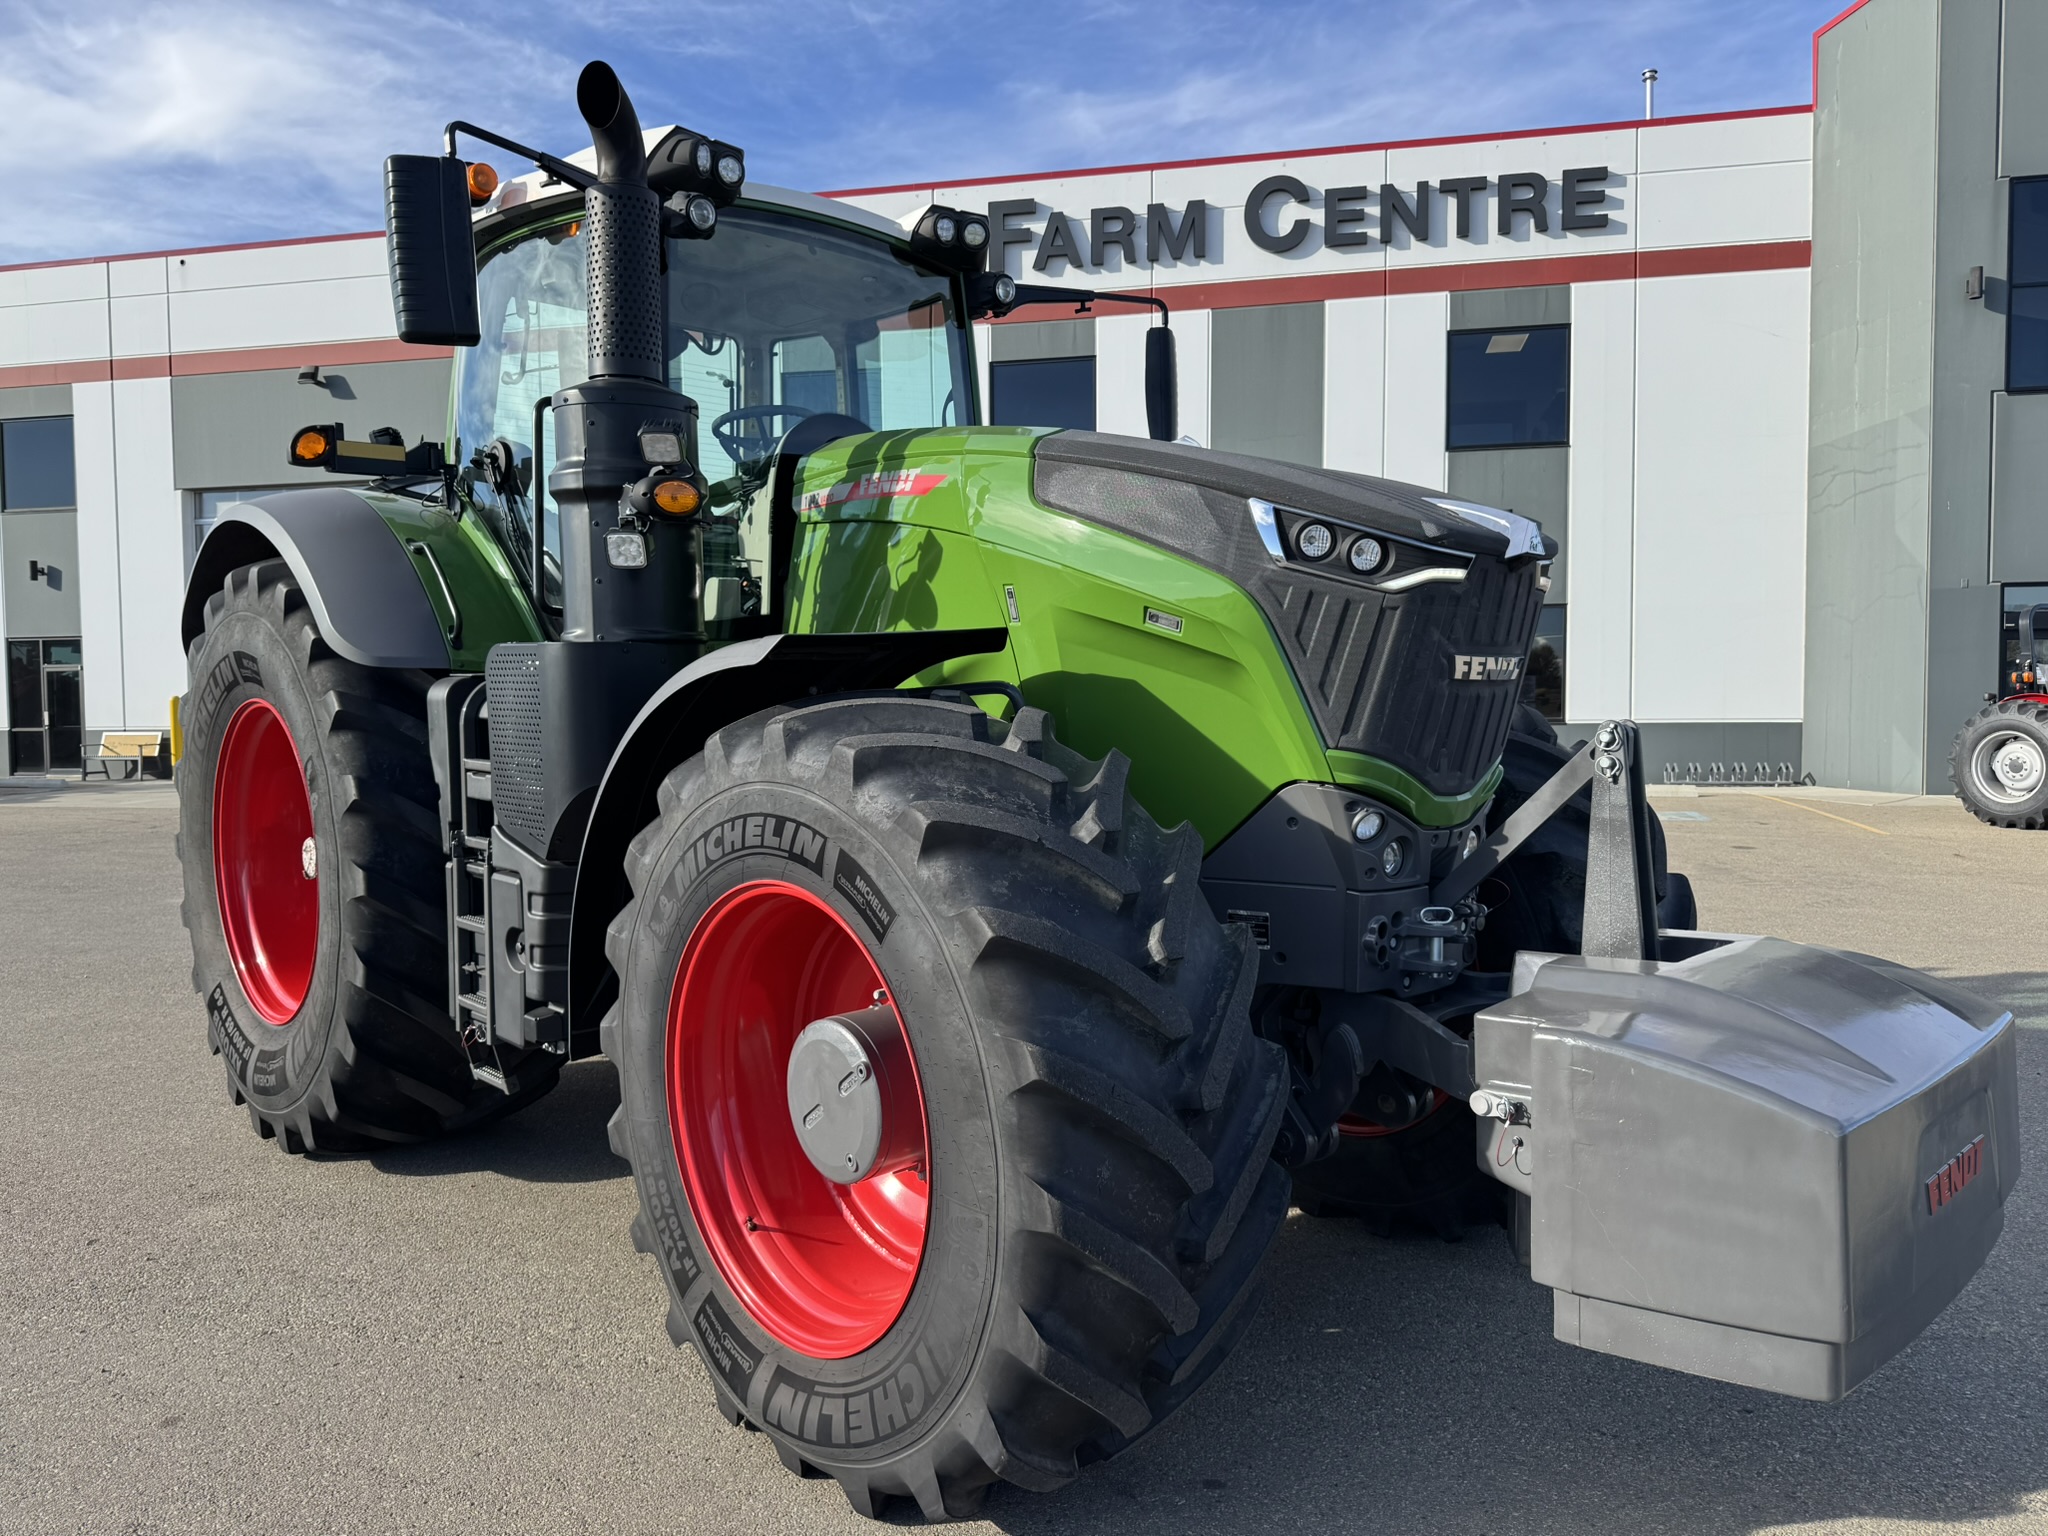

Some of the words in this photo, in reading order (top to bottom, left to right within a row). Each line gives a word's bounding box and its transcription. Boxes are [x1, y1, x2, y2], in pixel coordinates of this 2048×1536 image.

[988, 198, 1206, 272] FARM
[1245, 166, 1610, 253] CENTRE
[859, 467, 922, 495] FENDT
[1454, 654, 1525, 680] FENDT
[185, 656, 235, 785] ICHELIN
[673, 815, 826, 898] MICHELIN
[855, 875, 890, 925] MICHELIN
[1925, 1134, 1985, 1216] FENDT
[658, 1178, 687, 1252] 710/60
[683, 1256, 698, 1279] IF
[698, 1313, 731, 1373] MICHELIN
